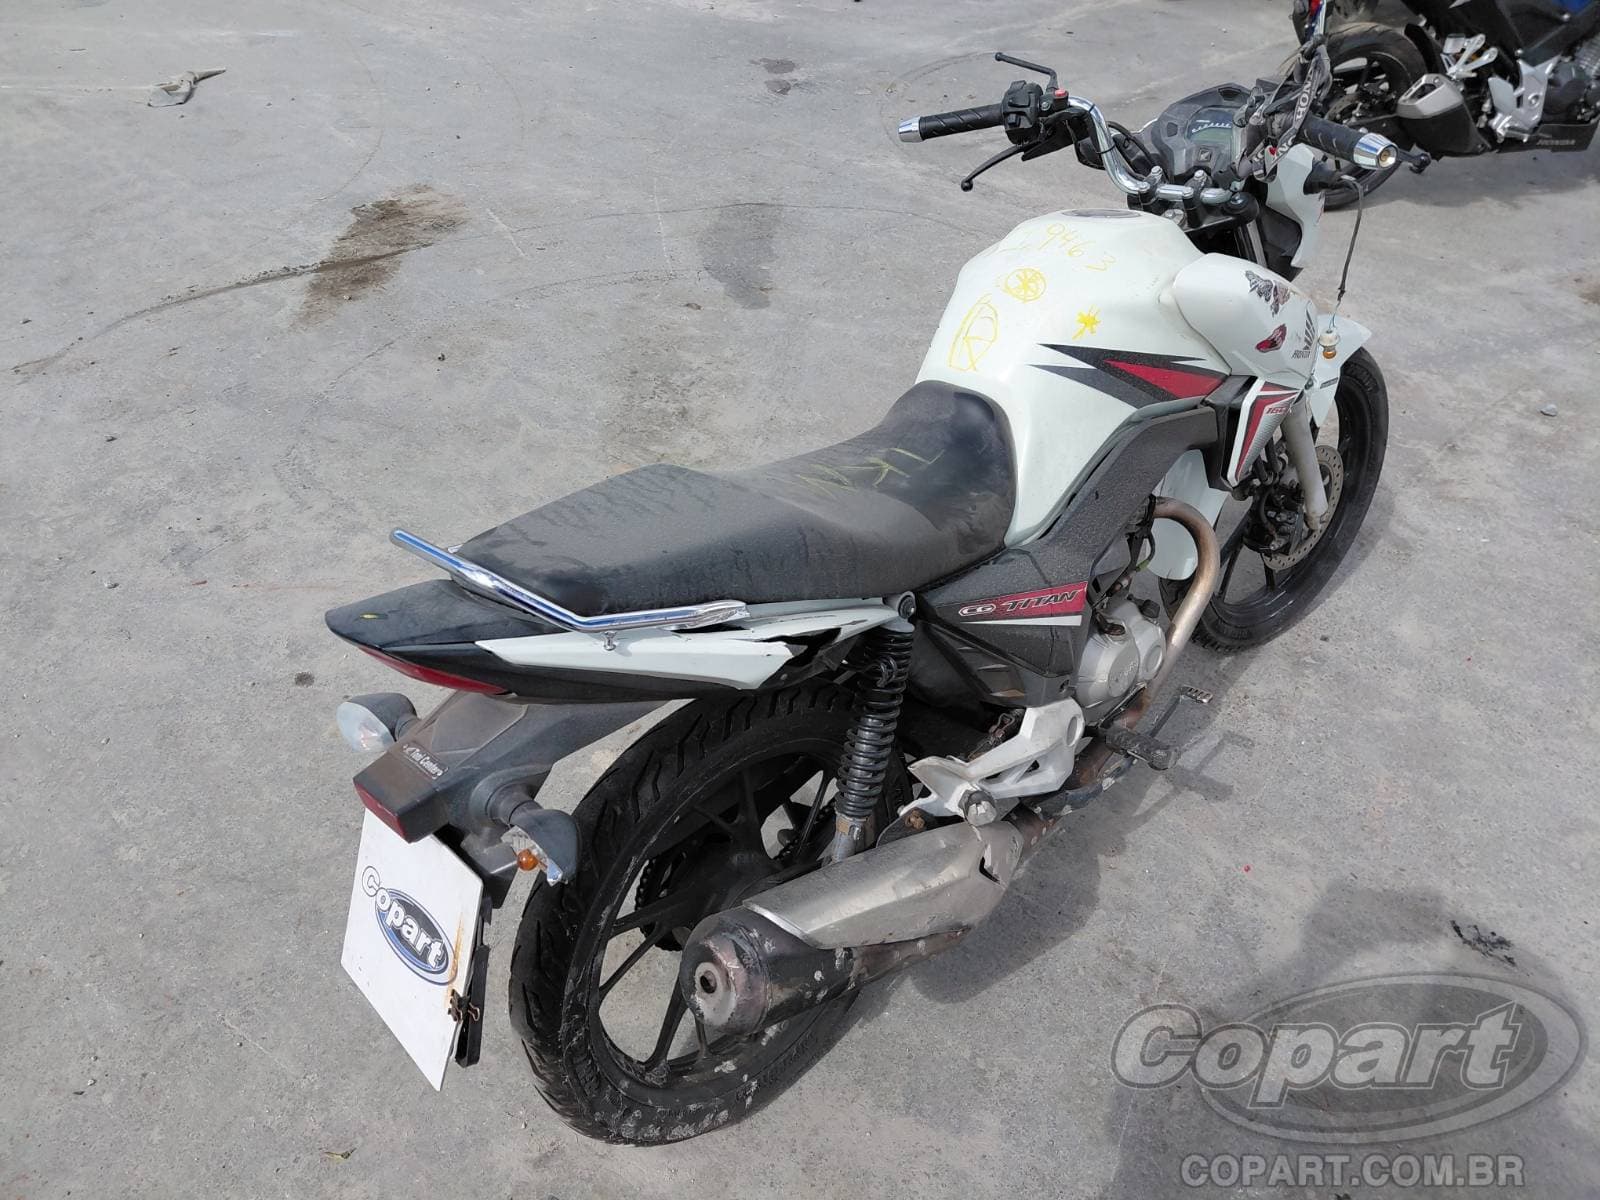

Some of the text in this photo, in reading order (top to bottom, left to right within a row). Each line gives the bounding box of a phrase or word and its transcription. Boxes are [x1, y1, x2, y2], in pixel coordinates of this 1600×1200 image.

[958, 590, 1080, 617] CG TITAN
[362, 865, 444, 969] Copart
